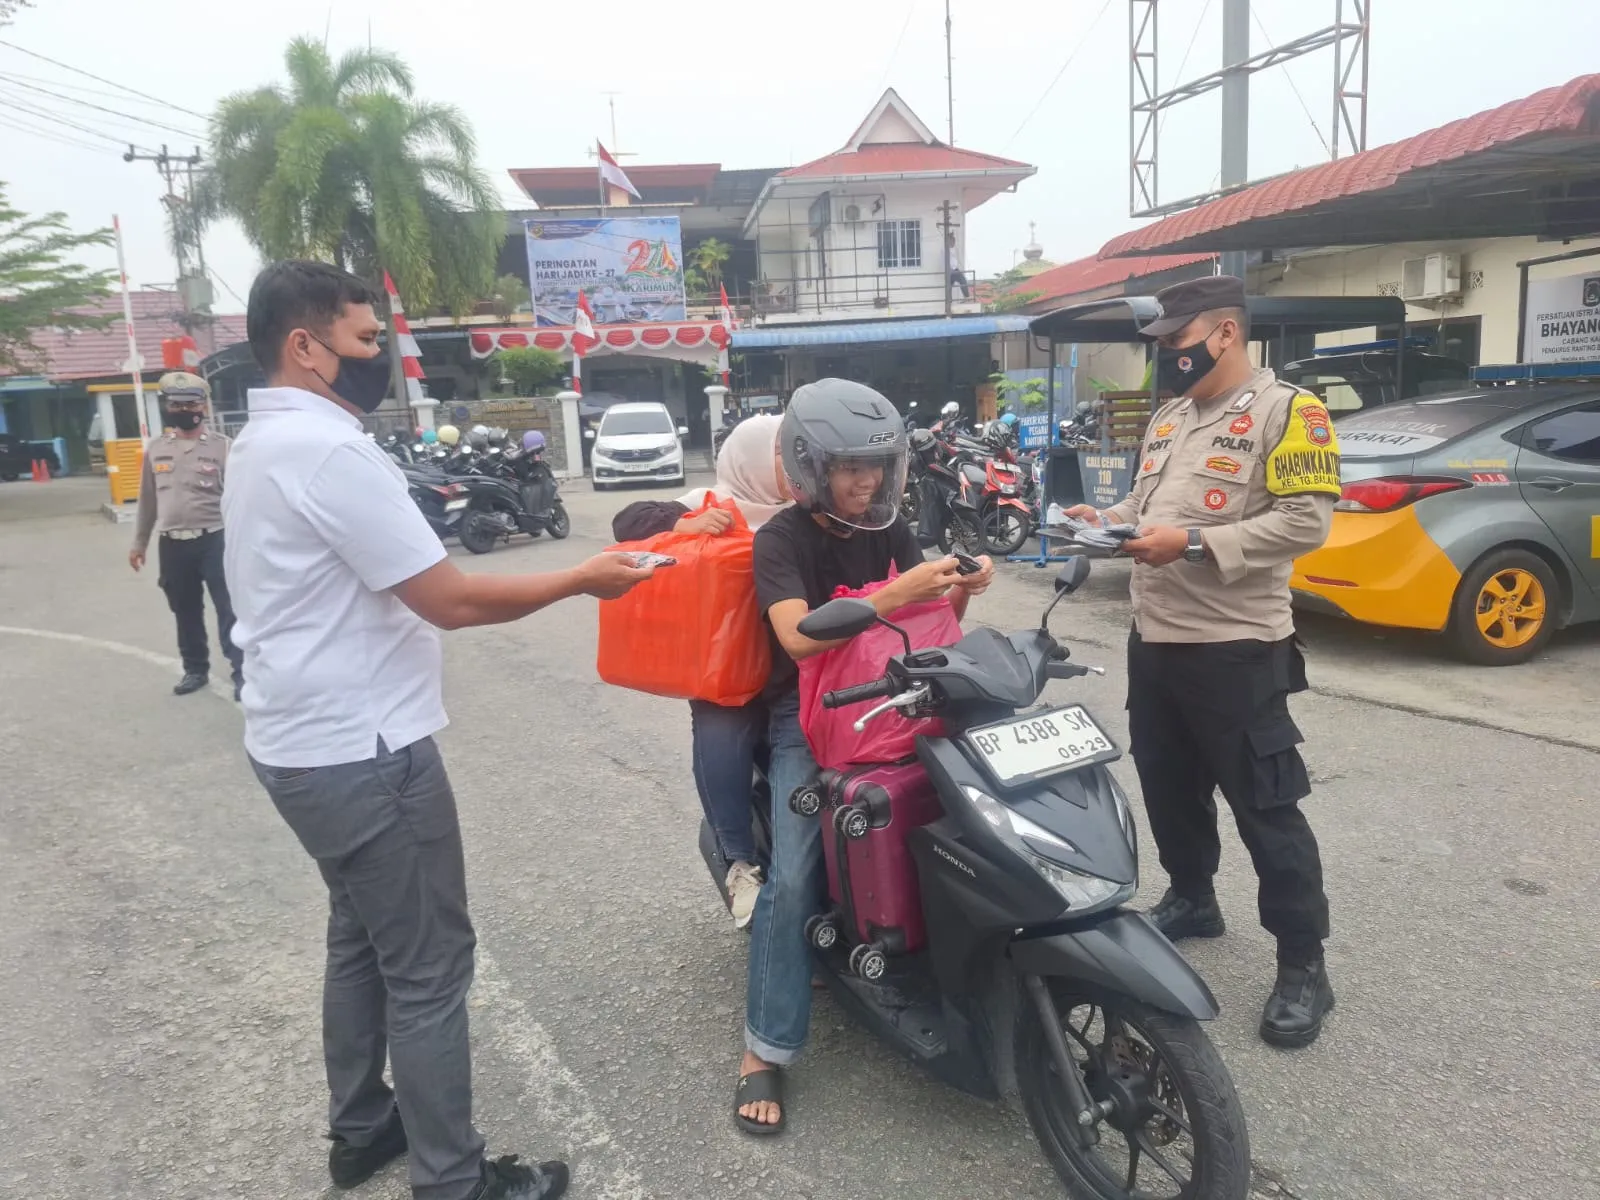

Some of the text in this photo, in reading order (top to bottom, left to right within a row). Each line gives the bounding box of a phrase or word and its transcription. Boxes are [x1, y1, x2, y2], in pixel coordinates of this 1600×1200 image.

[535, 259, 597, 270] PERINGATAN
[536, 271, 560, 280] HARI
[561, 270, 584, 279] JADI
[585, 270, 598, 278] KE
[605, 269, 615, 278] 27
[1537, 312, 1575, 321] PERSATUAN
[1594, 307, 1600, 315] A
[1211, 436, 1254, 453] POLRI
[1098, 470, 1112, 485] 110
[975, 710, 1092, 756] BP 4388 SK
[933, 844, 977, 878] HONDA
